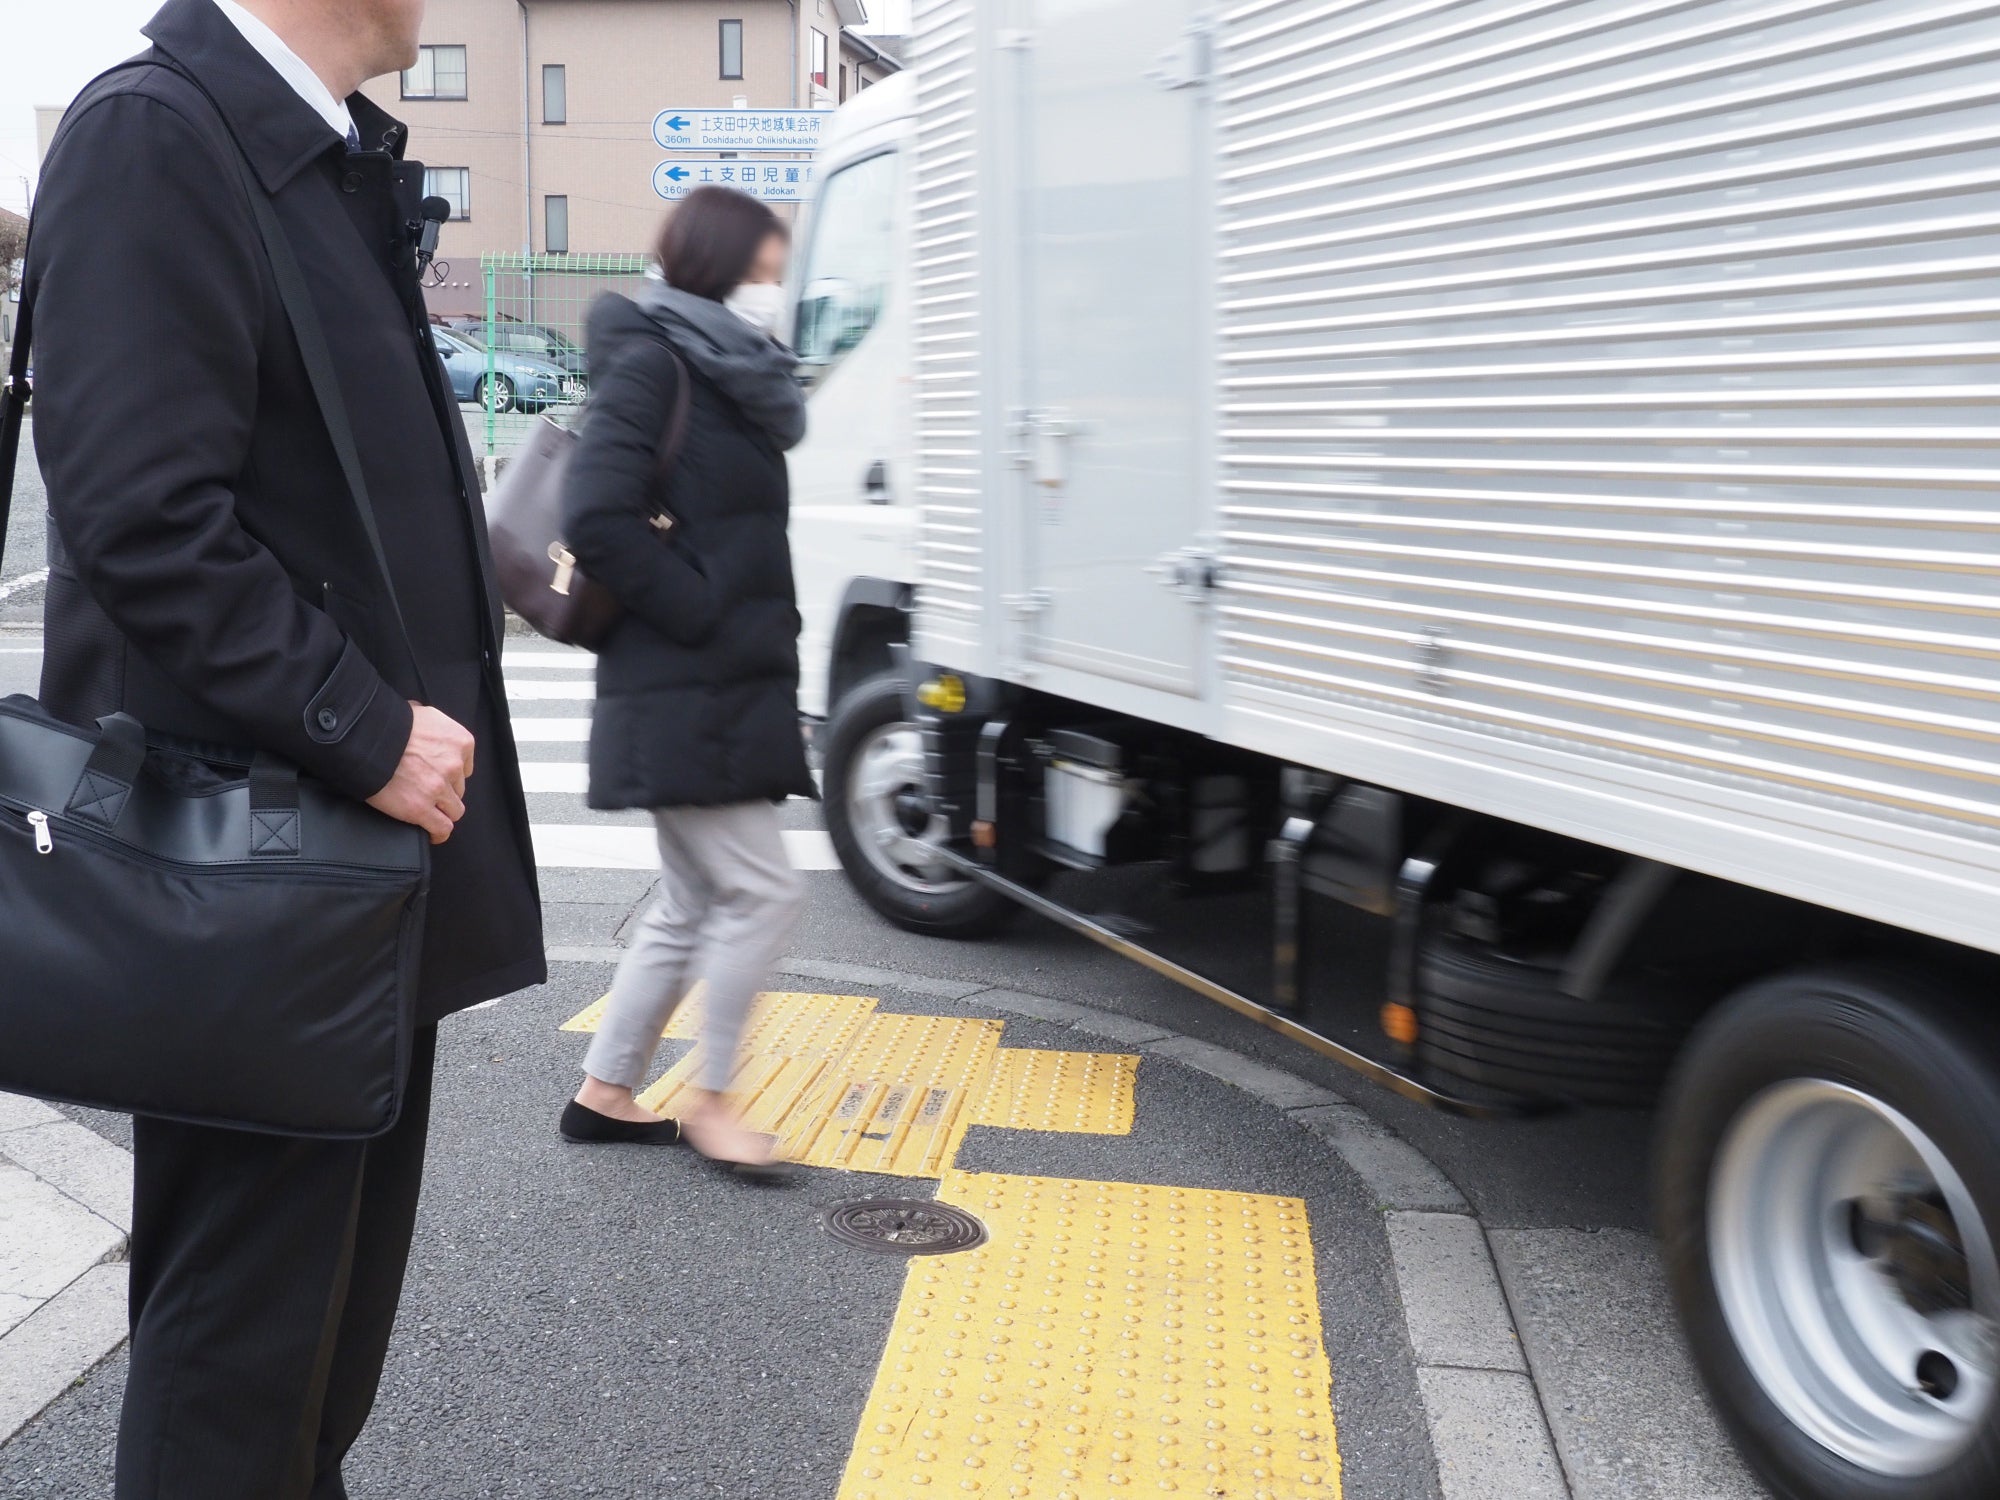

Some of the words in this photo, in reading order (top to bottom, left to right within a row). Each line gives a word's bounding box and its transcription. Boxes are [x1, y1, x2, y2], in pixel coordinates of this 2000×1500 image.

[700, 116, 821, 133] 土支田中央地域集会所
[664, 135, 691, 144] 360m
[702, 135, 753, 144] Doshidachuo
[756, 135, 819, 145] Chiikishukaisho
[663, 186, 691, 195] 360m
[763, 186, 796, 196] Jidokan
